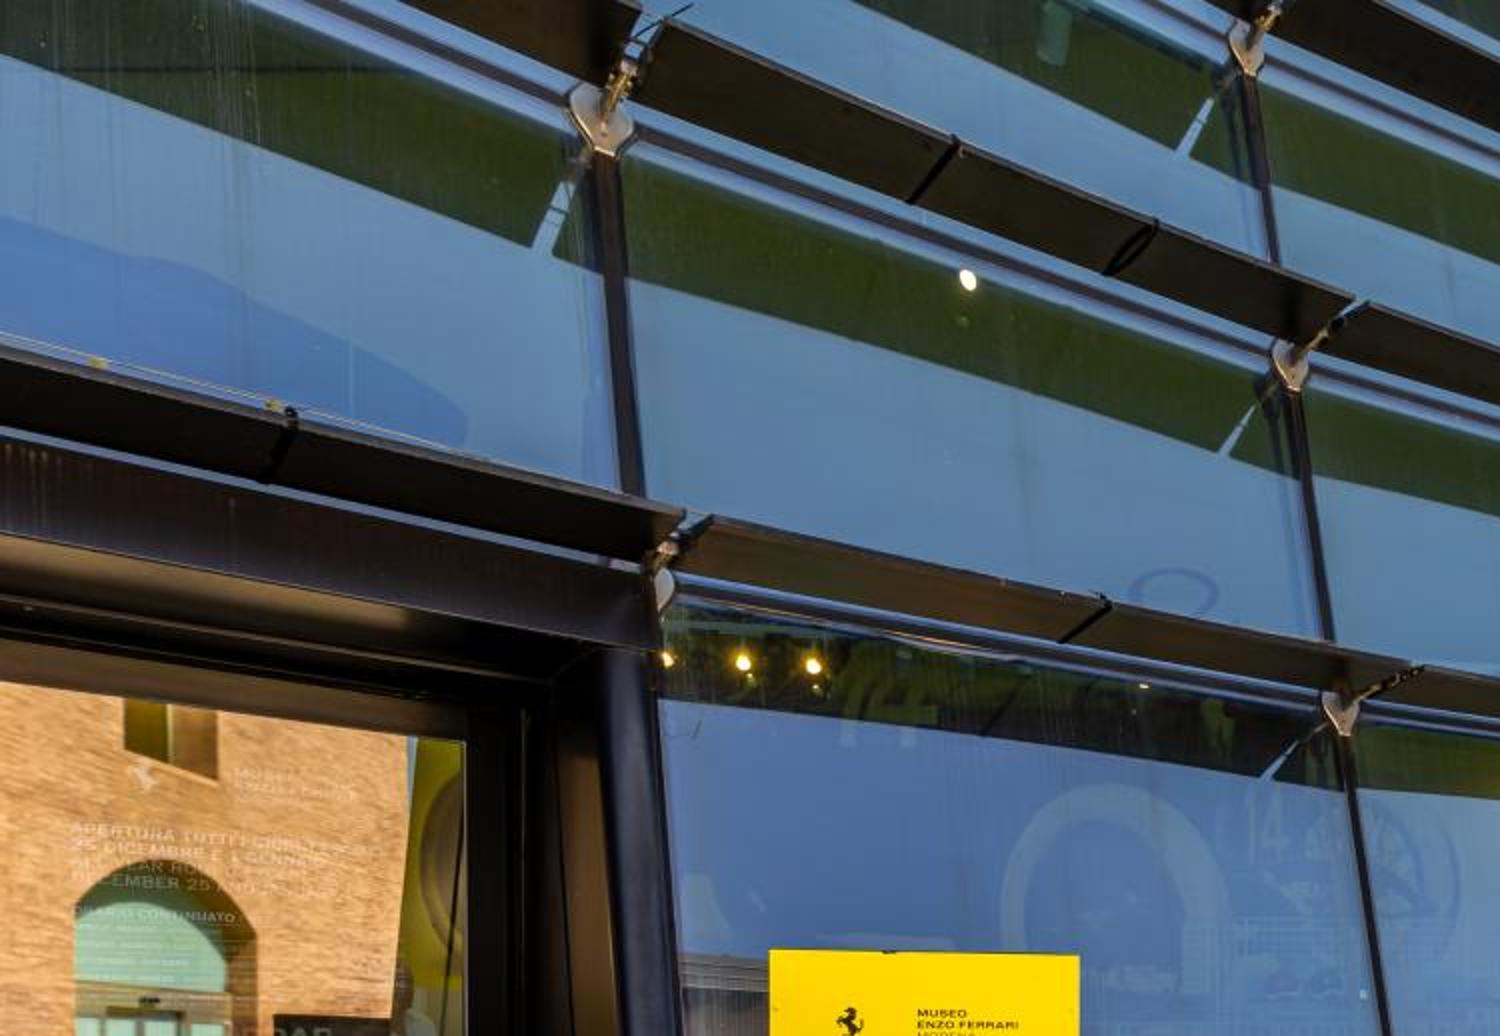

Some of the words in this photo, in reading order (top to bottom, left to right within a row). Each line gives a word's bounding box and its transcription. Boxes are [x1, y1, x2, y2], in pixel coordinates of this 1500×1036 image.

[916, 1008, 968, 1019] MUSEO
[916, 1020, 955, 1030] ENZO
[959, 1020, 1020, 1031] FERRARI
